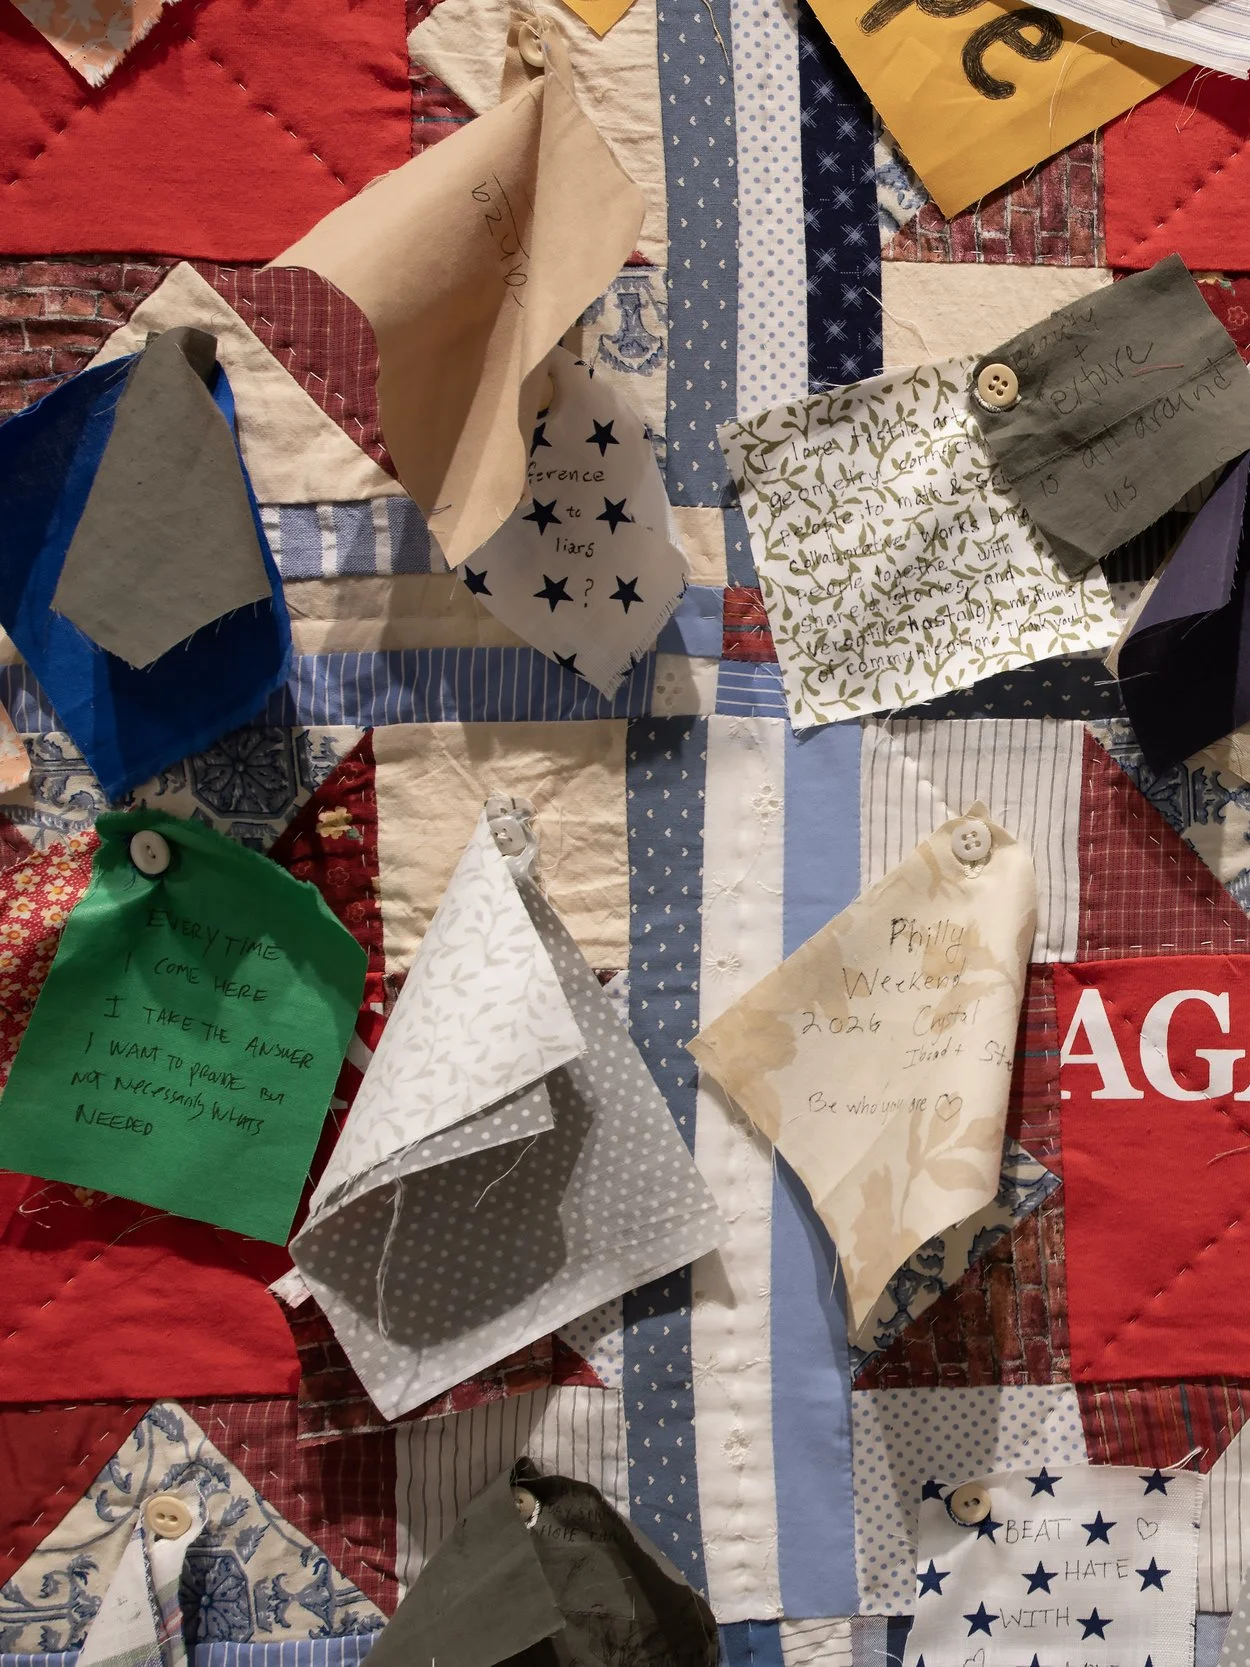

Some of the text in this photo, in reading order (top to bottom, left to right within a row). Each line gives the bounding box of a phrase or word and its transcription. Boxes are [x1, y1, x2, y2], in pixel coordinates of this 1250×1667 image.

[791, 439, 835, 463] love
[769, 469, 883, 518] geometry
[779, 511, 853, 549] people
[864, 500, 885, 517] to
[898, 482, 943, 509] math
[556, 537, 595, 558] liars
[789, 535, 903, 573] collaborative
[795, 538, 1014, 607] people together with
[983, 566, 1015, 587] and
[1009, 585, 1077, 610] mediums
[818, 658, 837, 684] of
[1001, 614, 1046, 637] Thank
[146, 909, 283, 961] EVERY TIME
[889, 917, 965, 964] Philly
[154, 957, 200, 985] COME
[213, 975, 268, 1002] HERE
[842, 956, 967, 1000] Weekend
[104, 998, 315, 1070] I TAKE THE ANSWER
[801, 1011, 882, 1034] 2026
[109, 1039, 163, 1062] WANT
[75, 1104, 153, 1136] NEEDED
[808, 1091, 837, 1113] Be
[846, 1095, 877, 1115] who
[881, 1098, 904, 1126] you
[1005, 1518, 1072, 1544] BEAT
[1065, 1558, 1130, 1581] HATE
[1000, 1606, 1070, 1629] WITH
